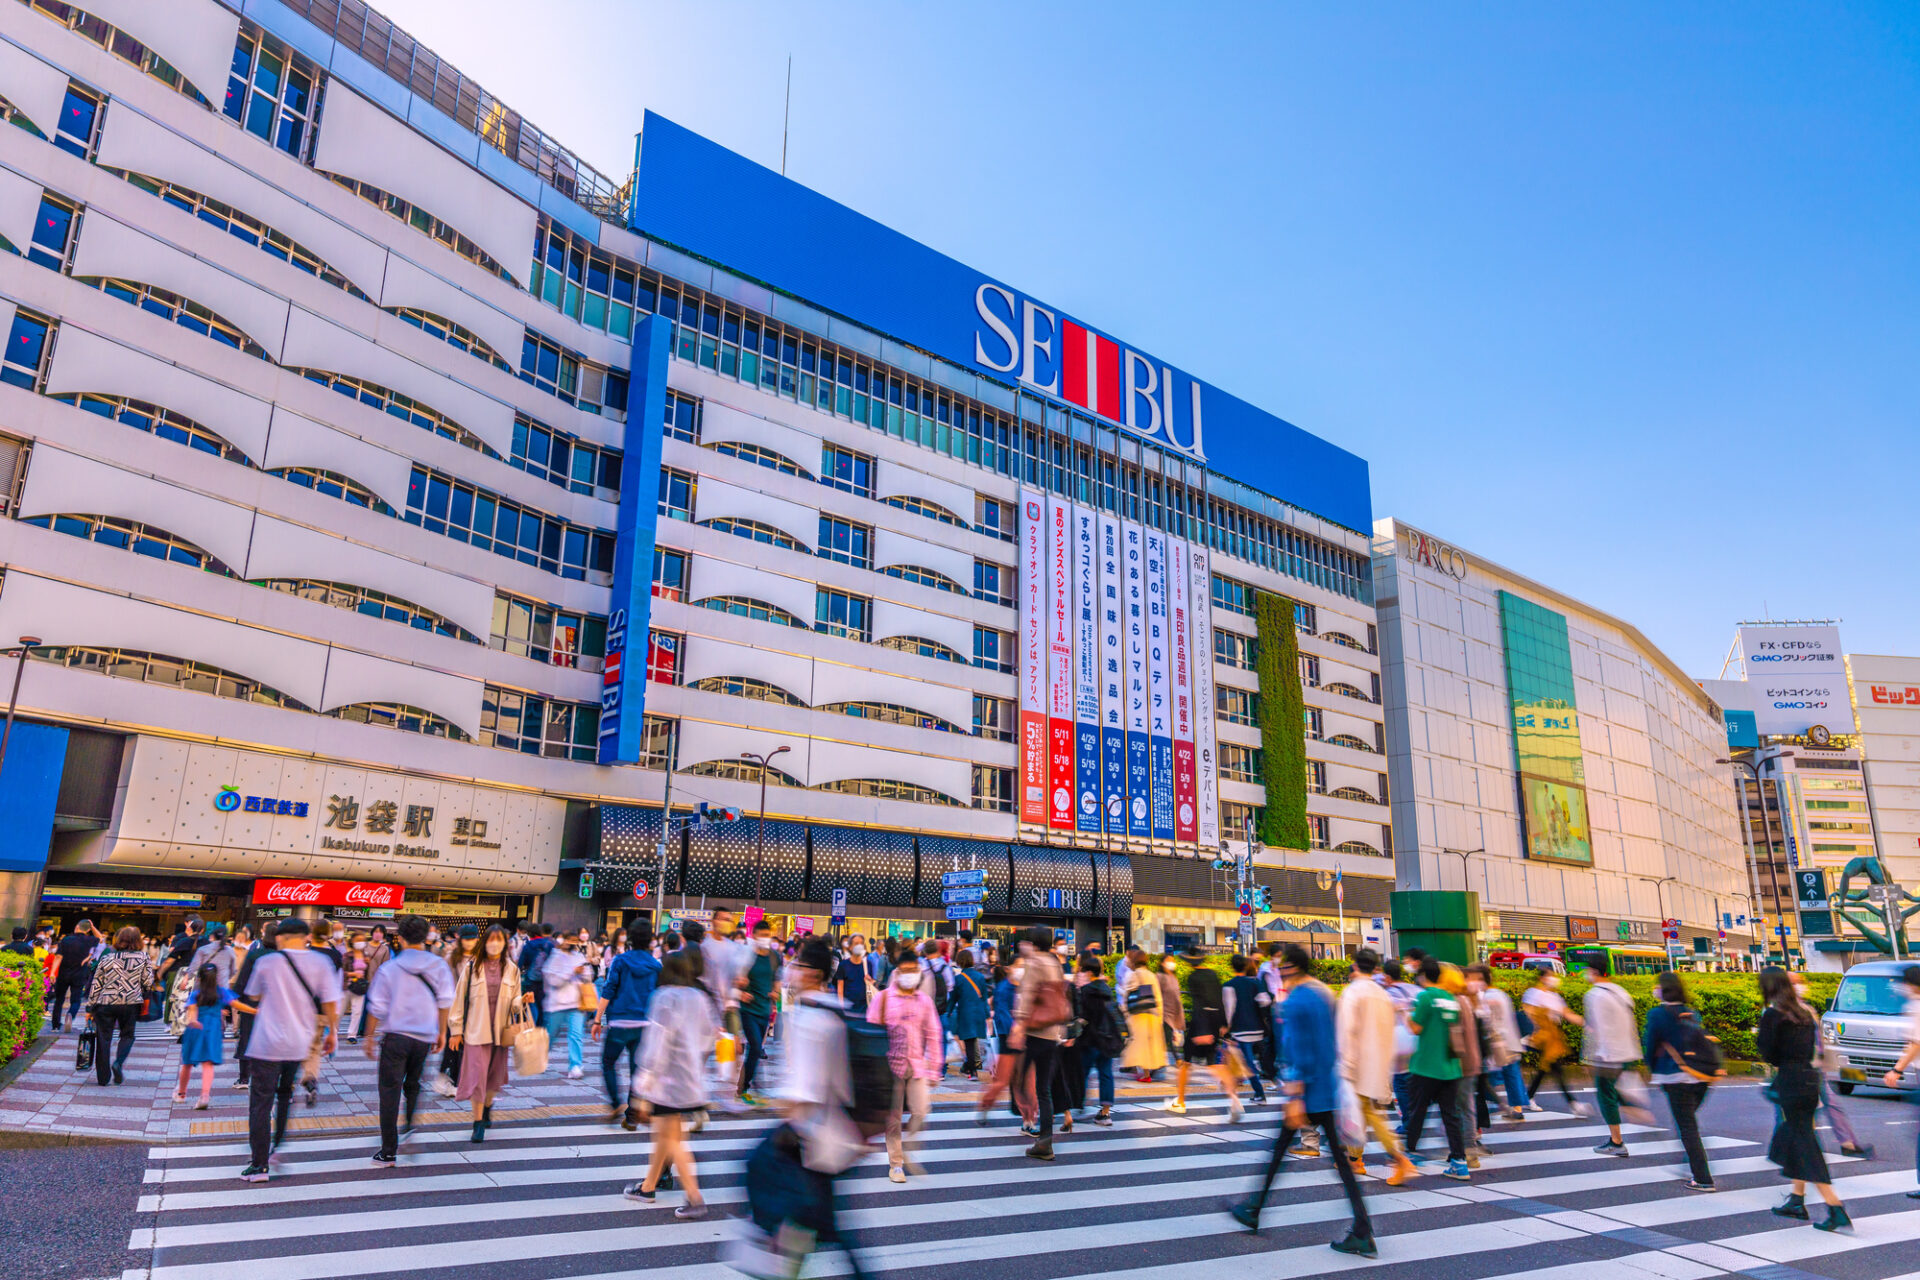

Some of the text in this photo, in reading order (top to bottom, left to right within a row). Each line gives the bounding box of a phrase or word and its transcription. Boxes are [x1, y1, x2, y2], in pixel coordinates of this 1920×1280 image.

[975, 283, 1209, 463] SEIBU
[1405, 529, 1466, 580] PARCO
[1056, 506, 1065, 642] 夏のメンズスペシャルセール
[1081, 517, 1091, 621] すみっコぐらし展
[1128, 530, 1143, 727] 花のある暮らしマルシェ
[1148, 536, 1163, 731] 天空のBBQテラス
[1760, 641, 1822, 650] FX・CFDなら
[1751, 654, 1835, 663] GMOクリック証券
[600, 608, 626, 739] SEIBU
[1176, 607, 1188, 735] 無印良品週間 開催中
[1767, 688, 1830, 697] ビットコインなら
[1773, 701, 1828, 709] GMOコイン
[1054, 728, 1069, 740] 5/11
[1081, 733, 1096, 744] 4/29
[1107, 737, 1121, 748] 4/26
[1131, 741, 1145, 752] 5/25
[1054, 754, 1069, 765] 5/18
[1178, 749, 1191, 760] 4/22
[1081, 758, 1096, 770] 5/15
[1108, 762, 1119, 772] 5/9
[1132, 766, 1145, 776] 5/31
[1180, 773, 1190, 783] 5/9
[244, 795, 310, 818] 西武鉄道
[325, 794, 488, 838] 池袋駅 東口
[321, 836, 390, 855] Ikebukuro
[394, 842, 440, 859] Station
[267, 882, 325, 901] Coca-Cola
[345, 884, 394, 905] Coca-Cola
[834, 891, 844, 904] P
[1031, 887, 1081, 910] SEIBU
